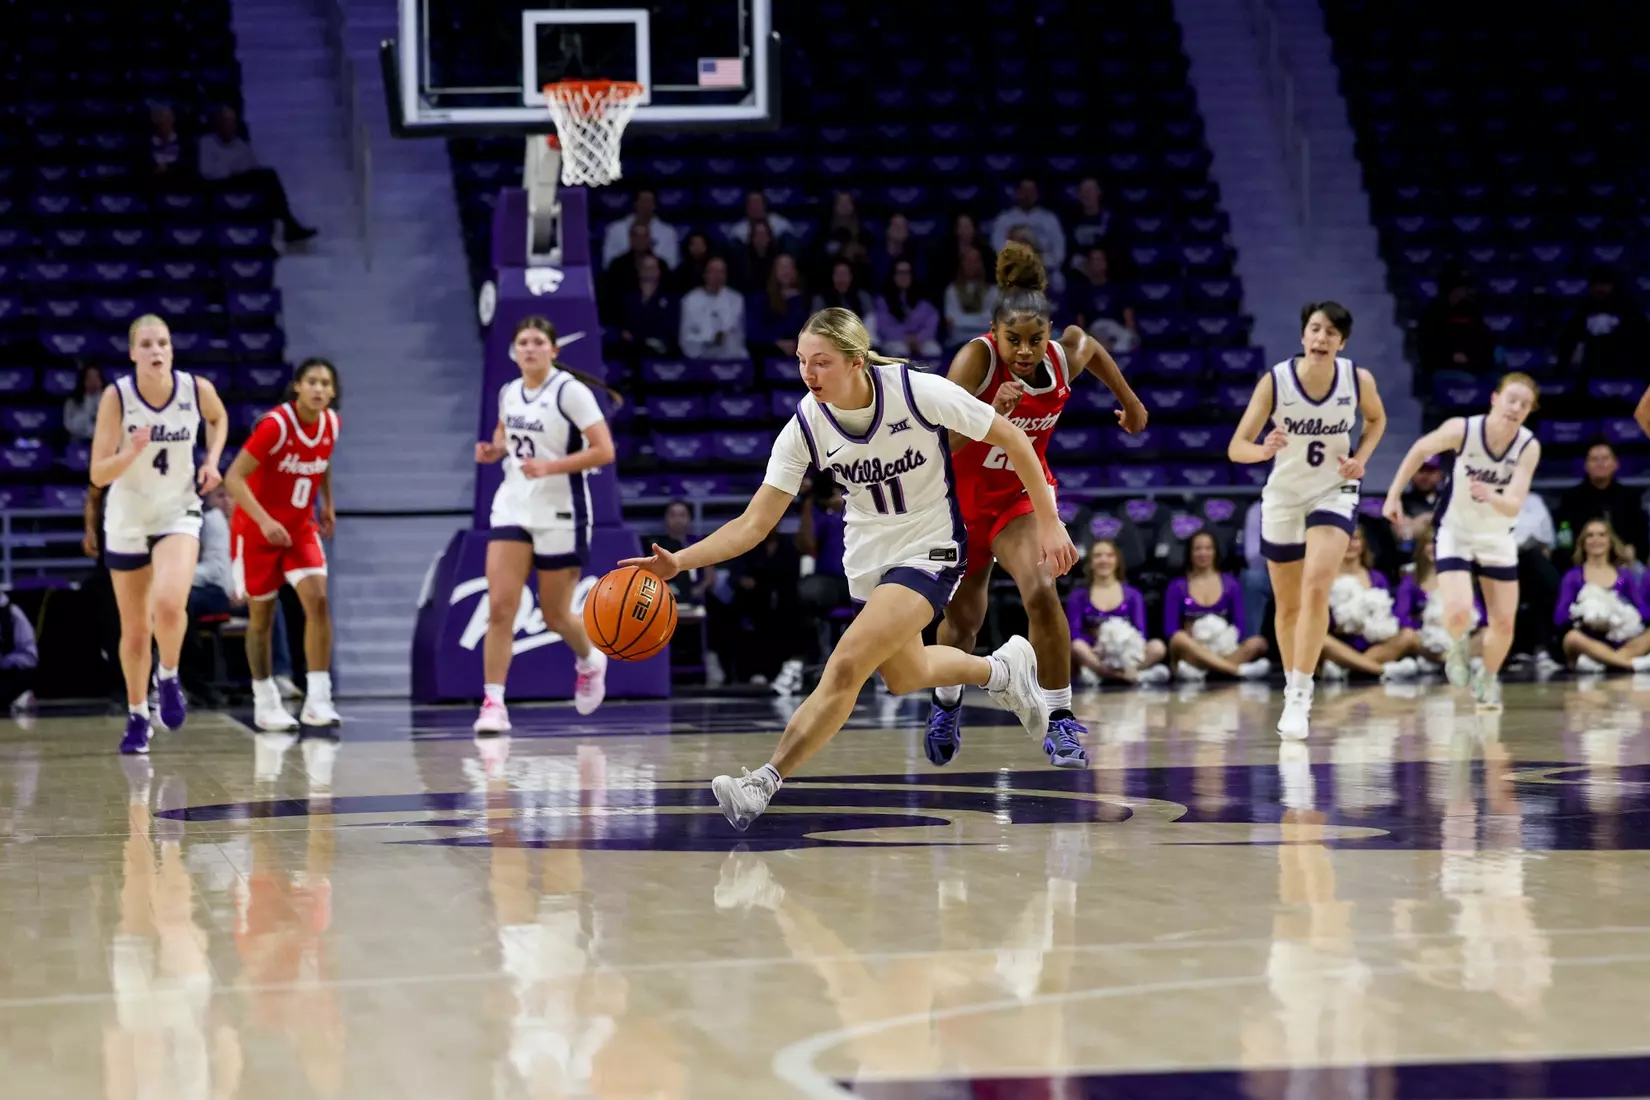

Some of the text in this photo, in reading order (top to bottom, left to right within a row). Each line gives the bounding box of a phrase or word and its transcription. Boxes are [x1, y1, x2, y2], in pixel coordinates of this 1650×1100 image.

[1284, 416, 1351, 435] Wildcats
[510, 434, 535, 459] 23
[1306, 441, 1326, 467] 6
[152, 448, 168, 475] 4
[832, 445, 927, 484] Wildcats
[291, 477, 313, 509] 0
[865, 476, 908, 515] 11
[632, 576, 657, 621] ELITE
